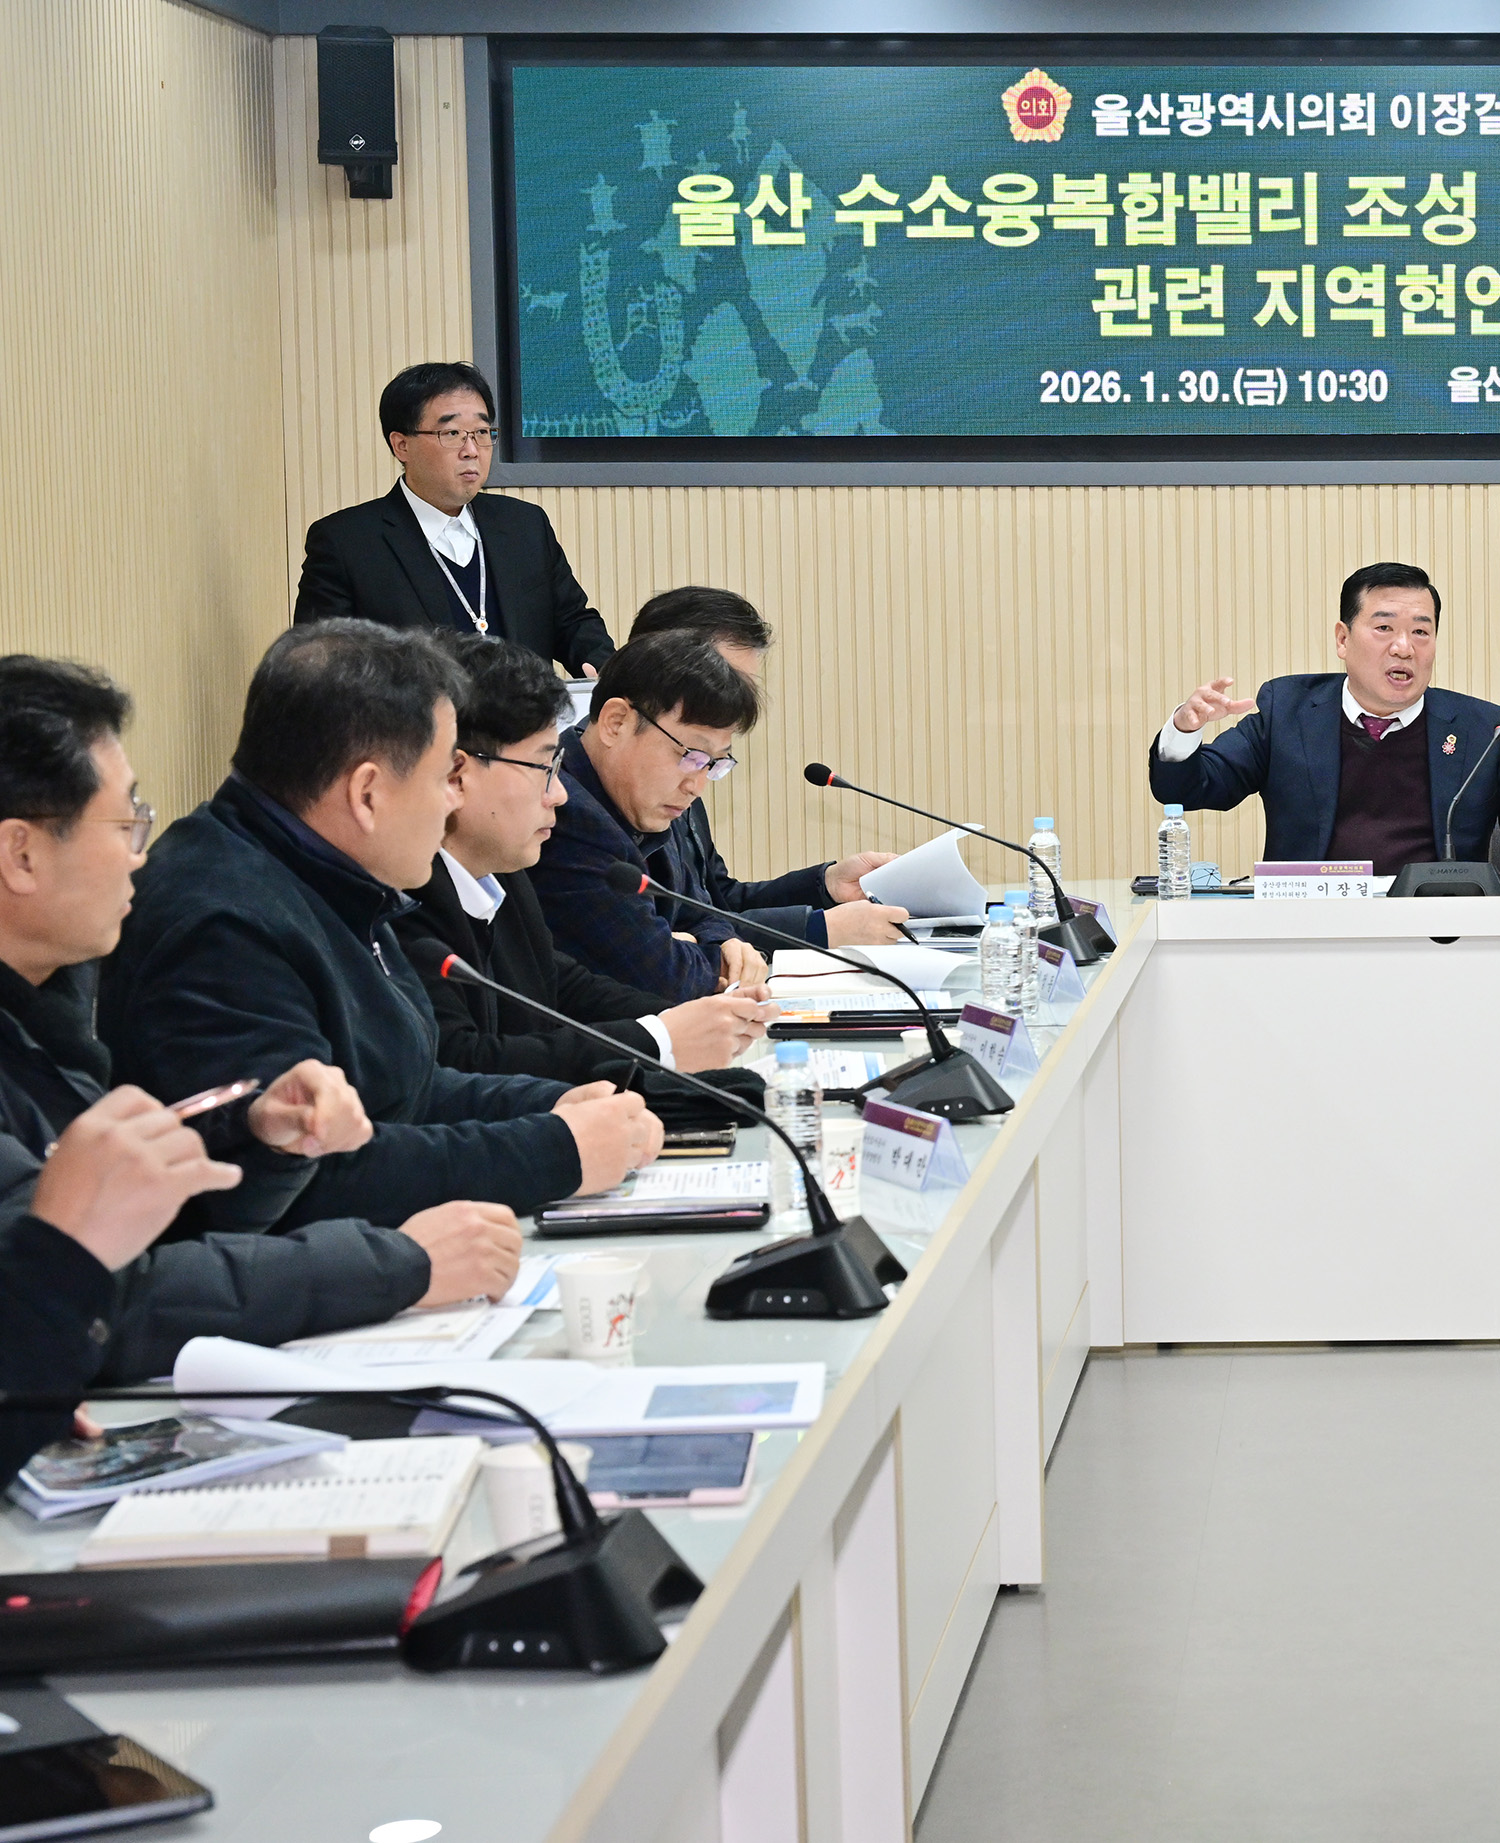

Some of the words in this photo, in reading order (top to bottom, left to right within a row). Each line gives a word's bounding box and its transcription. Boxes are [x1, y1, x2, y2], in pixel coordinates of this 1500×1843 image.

[1018, 97, 1056, 117] 의회
[1091, 92, 1377, 138] 울산광역시의회
[671, 172, 813, 248] 울산
[834, 171, 1320, 249] 수소융복합밸리
[1342, 170, 1479, 248] 조성
[1091, 264, 1227, 339] 관련
[1039, 370, 1132, 404] 2026.
[1298, 369, 1390, 403] 10:30
